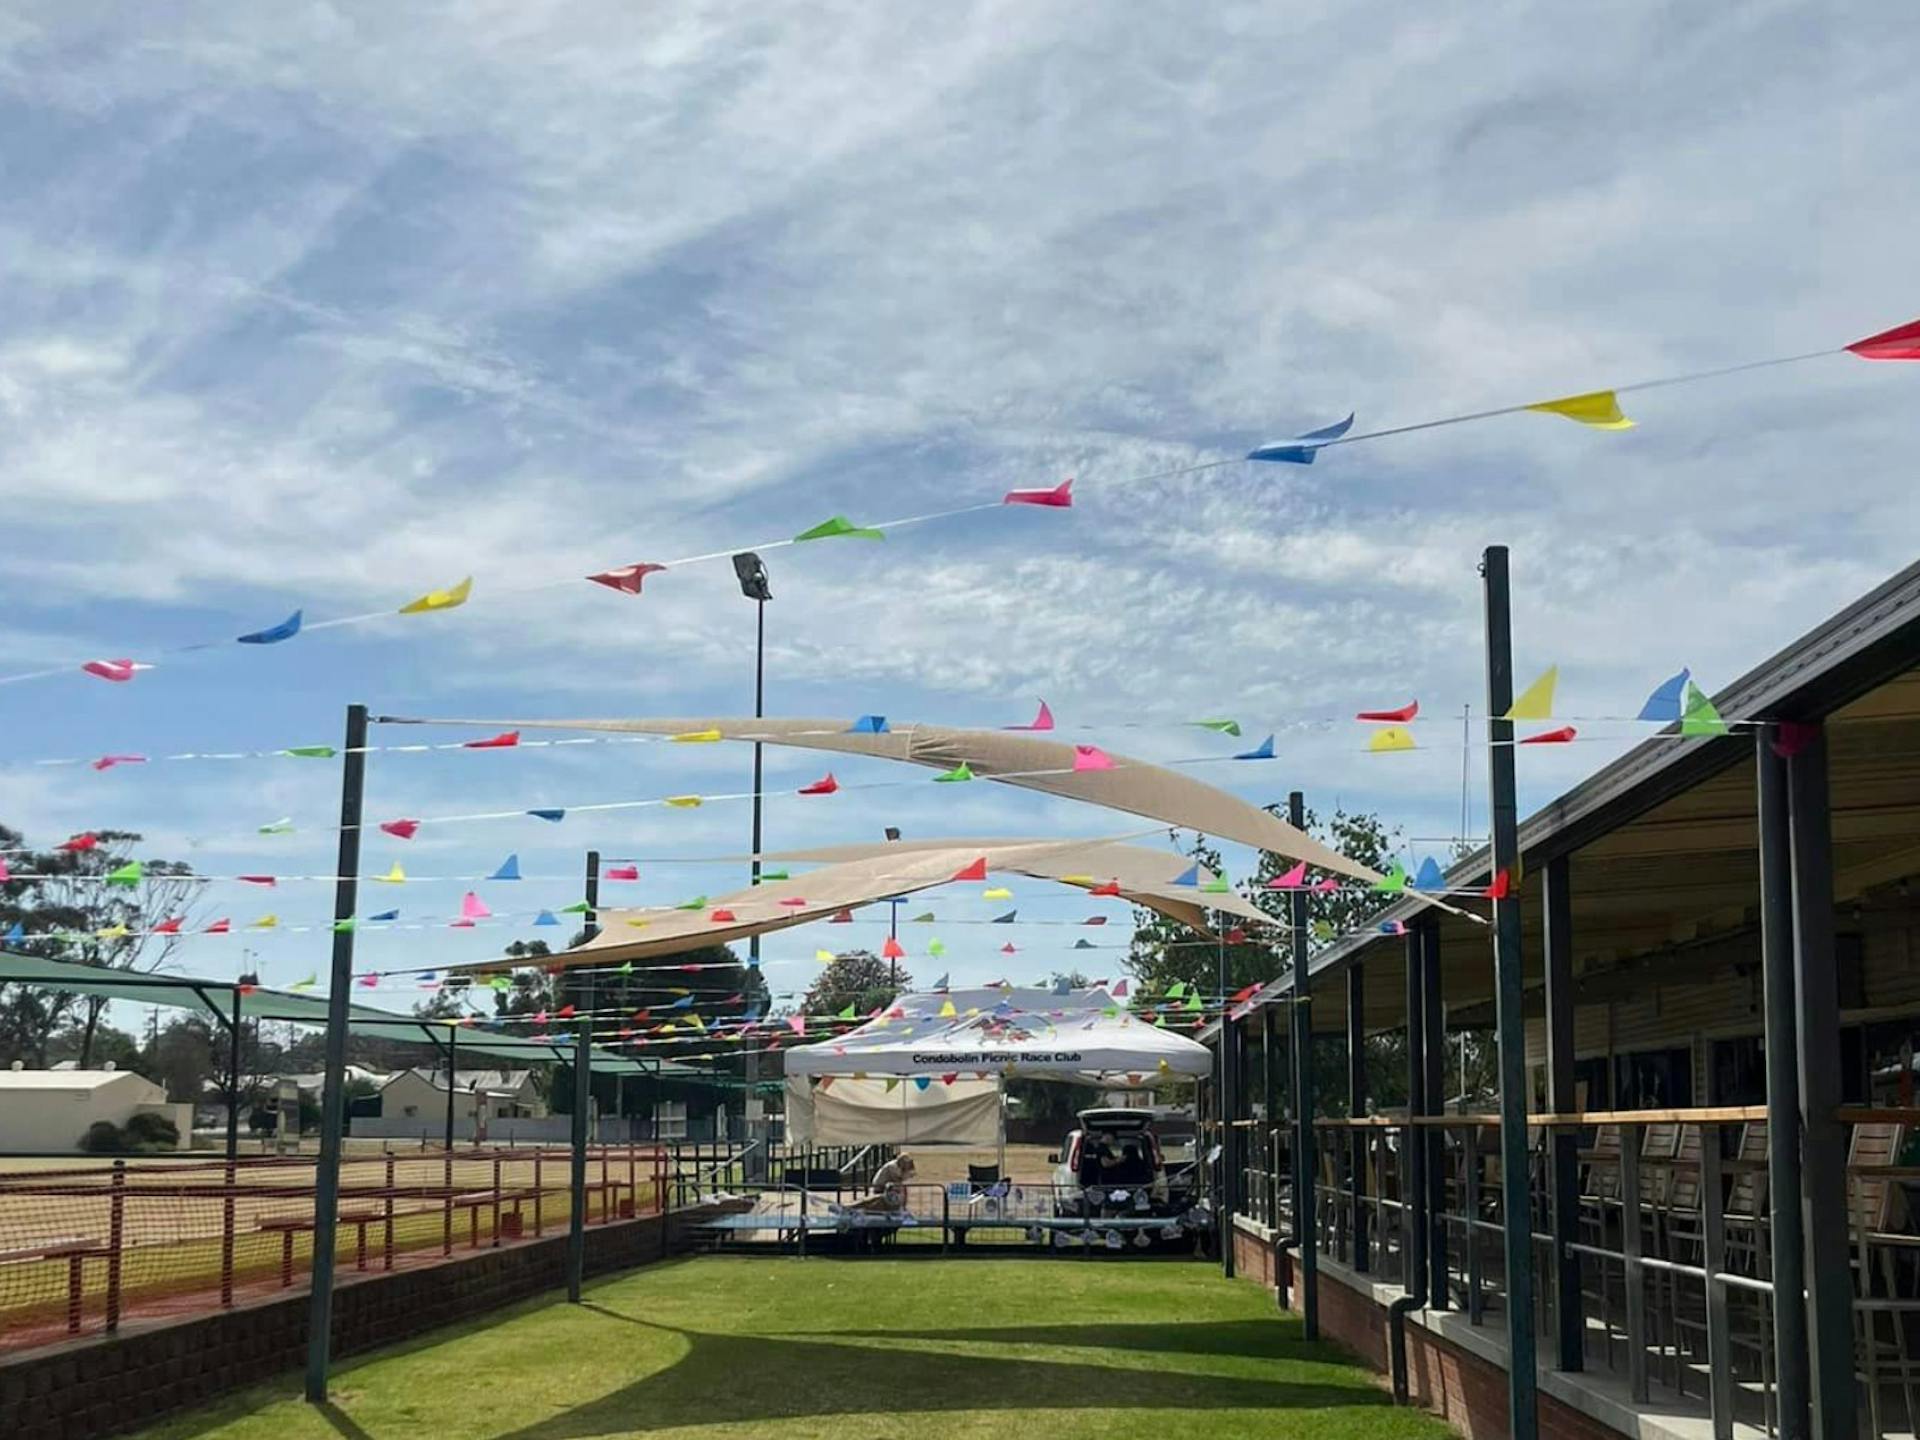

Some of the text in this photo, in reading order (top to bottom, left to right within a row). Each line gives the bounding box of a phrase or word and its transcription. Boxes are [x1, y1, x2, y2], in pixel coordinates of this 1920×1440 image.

[913, 1051, 1081, 1064] Condobolin Picnic Race Club
